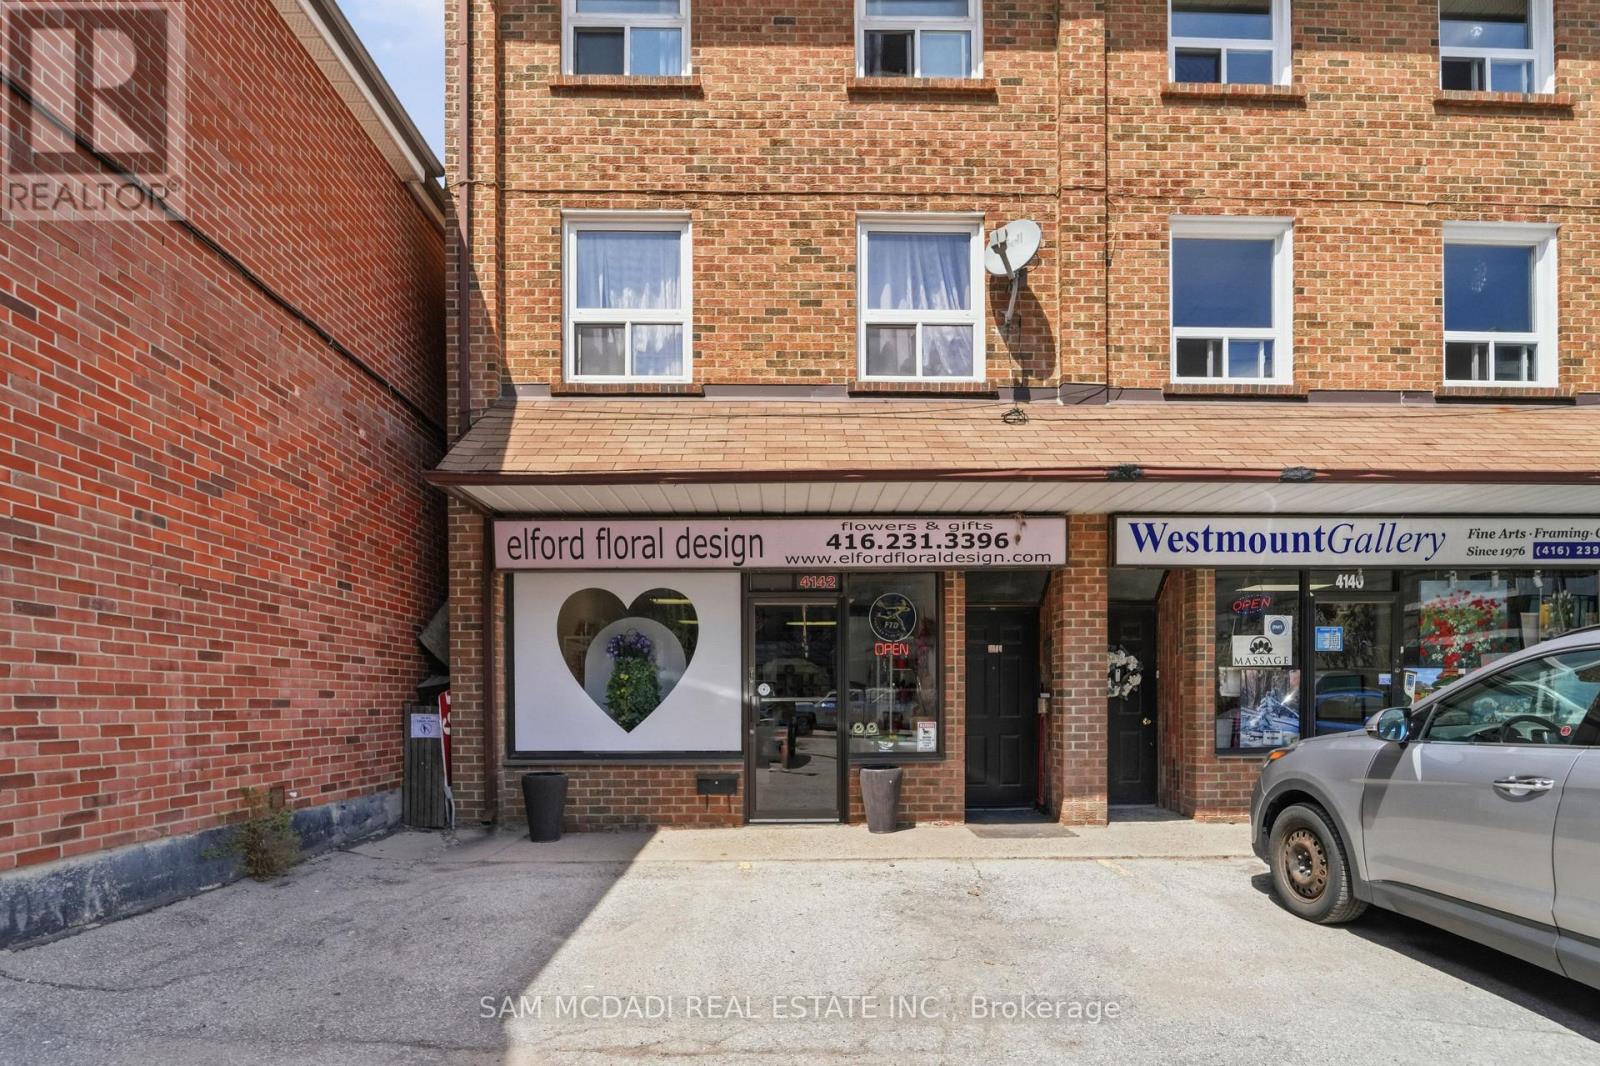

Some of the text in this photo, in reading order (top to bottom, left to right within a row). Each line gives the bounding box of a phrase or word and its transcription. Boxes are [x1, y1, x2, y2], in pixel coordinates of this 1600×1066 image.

[841, 521, 994, 532] flowers & gifts
[1466, 527, 1496, 539] Fine
[1498, 527, 1527, 539] Arts
[507, 526, 764, 567] elford floral design
[826, 532, 1010, 550] 416.231.3396
[1128, 522, 1447, 562] WestmountGallery
[785, 550, 1052, 566] www.elfordfloraldesign.com
[1466, 545, 1526, 558] Since 1976
[1535, 545, 1571, 557] (416)
[800, 575, 836, 589] 4142
[1335, 573, 1365, 589] 4140
[1232, 596, 1271, 611] OPEN
[874, 642, 909, 656] OPEN
[1234, 656, 1289, 665] MASSAGE
